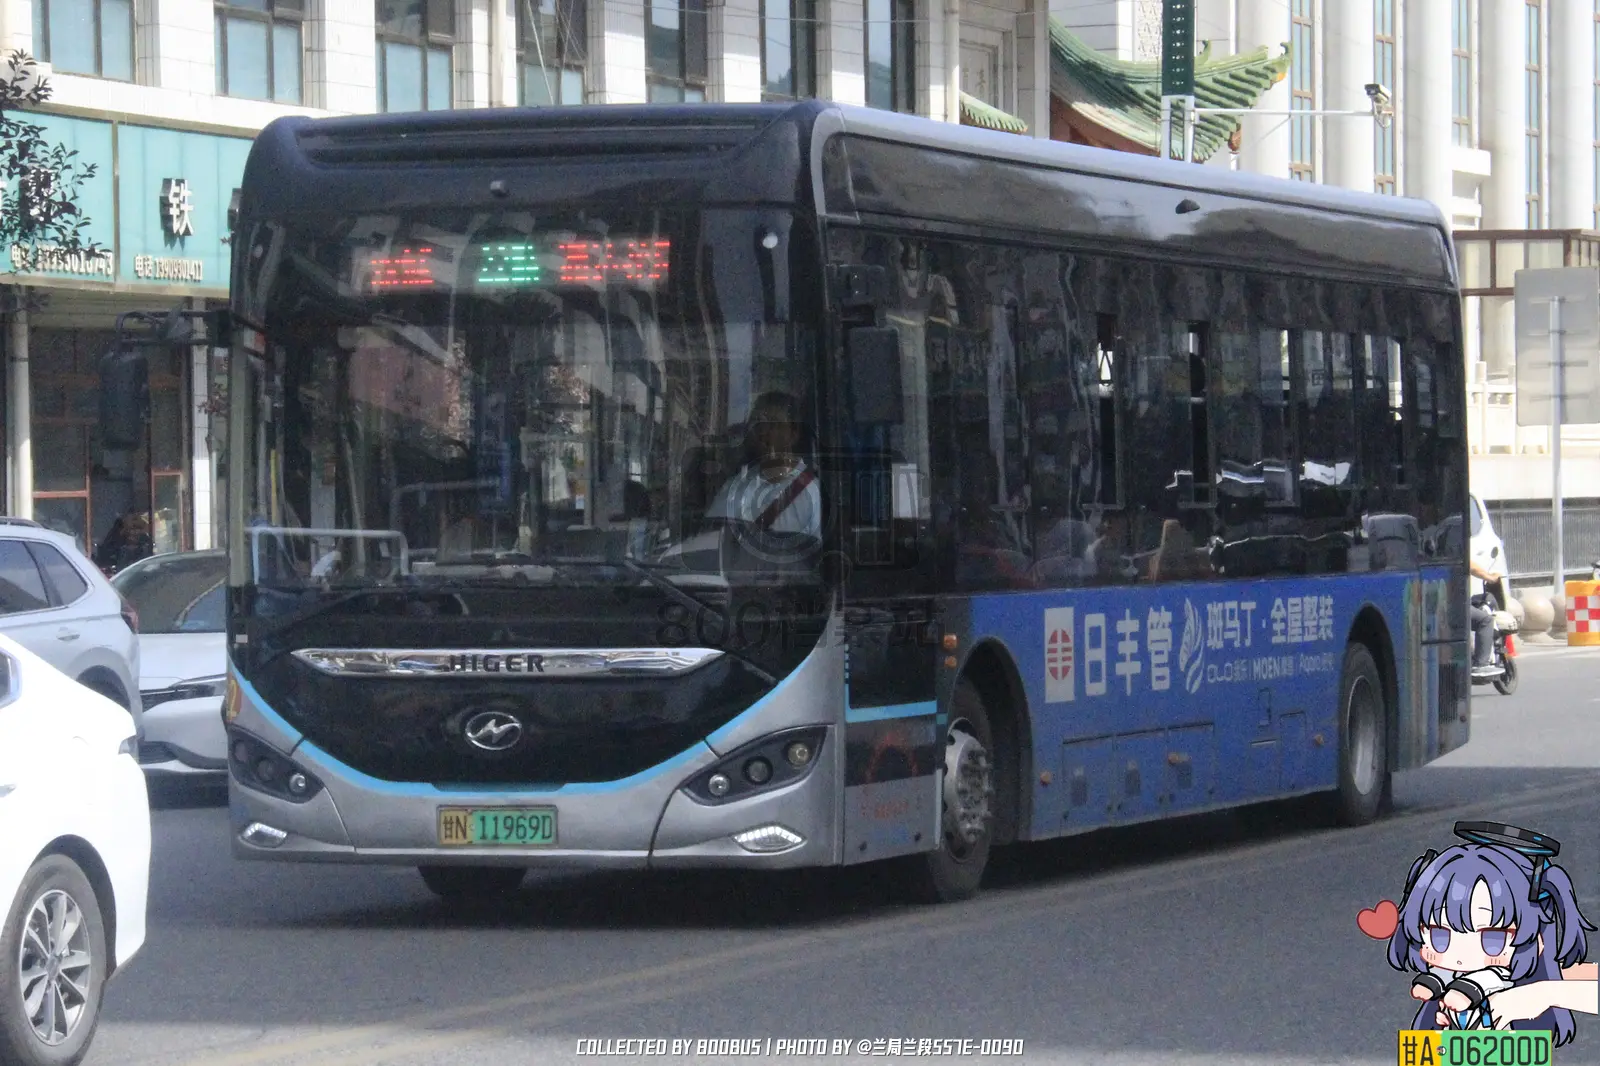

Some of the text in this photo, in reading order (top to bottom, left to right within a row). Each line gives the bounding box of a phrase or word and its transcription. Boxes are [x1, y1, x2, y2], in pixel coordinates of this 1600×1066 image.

[163, 178, 194, 237] 铁
[135, 253, 153, 278] 电话
[450, 654, 545, 673] HIGER
[1084, 606, 1173, 696] 日丰管
[442, 815, 553, 840] 甘N 11969D
